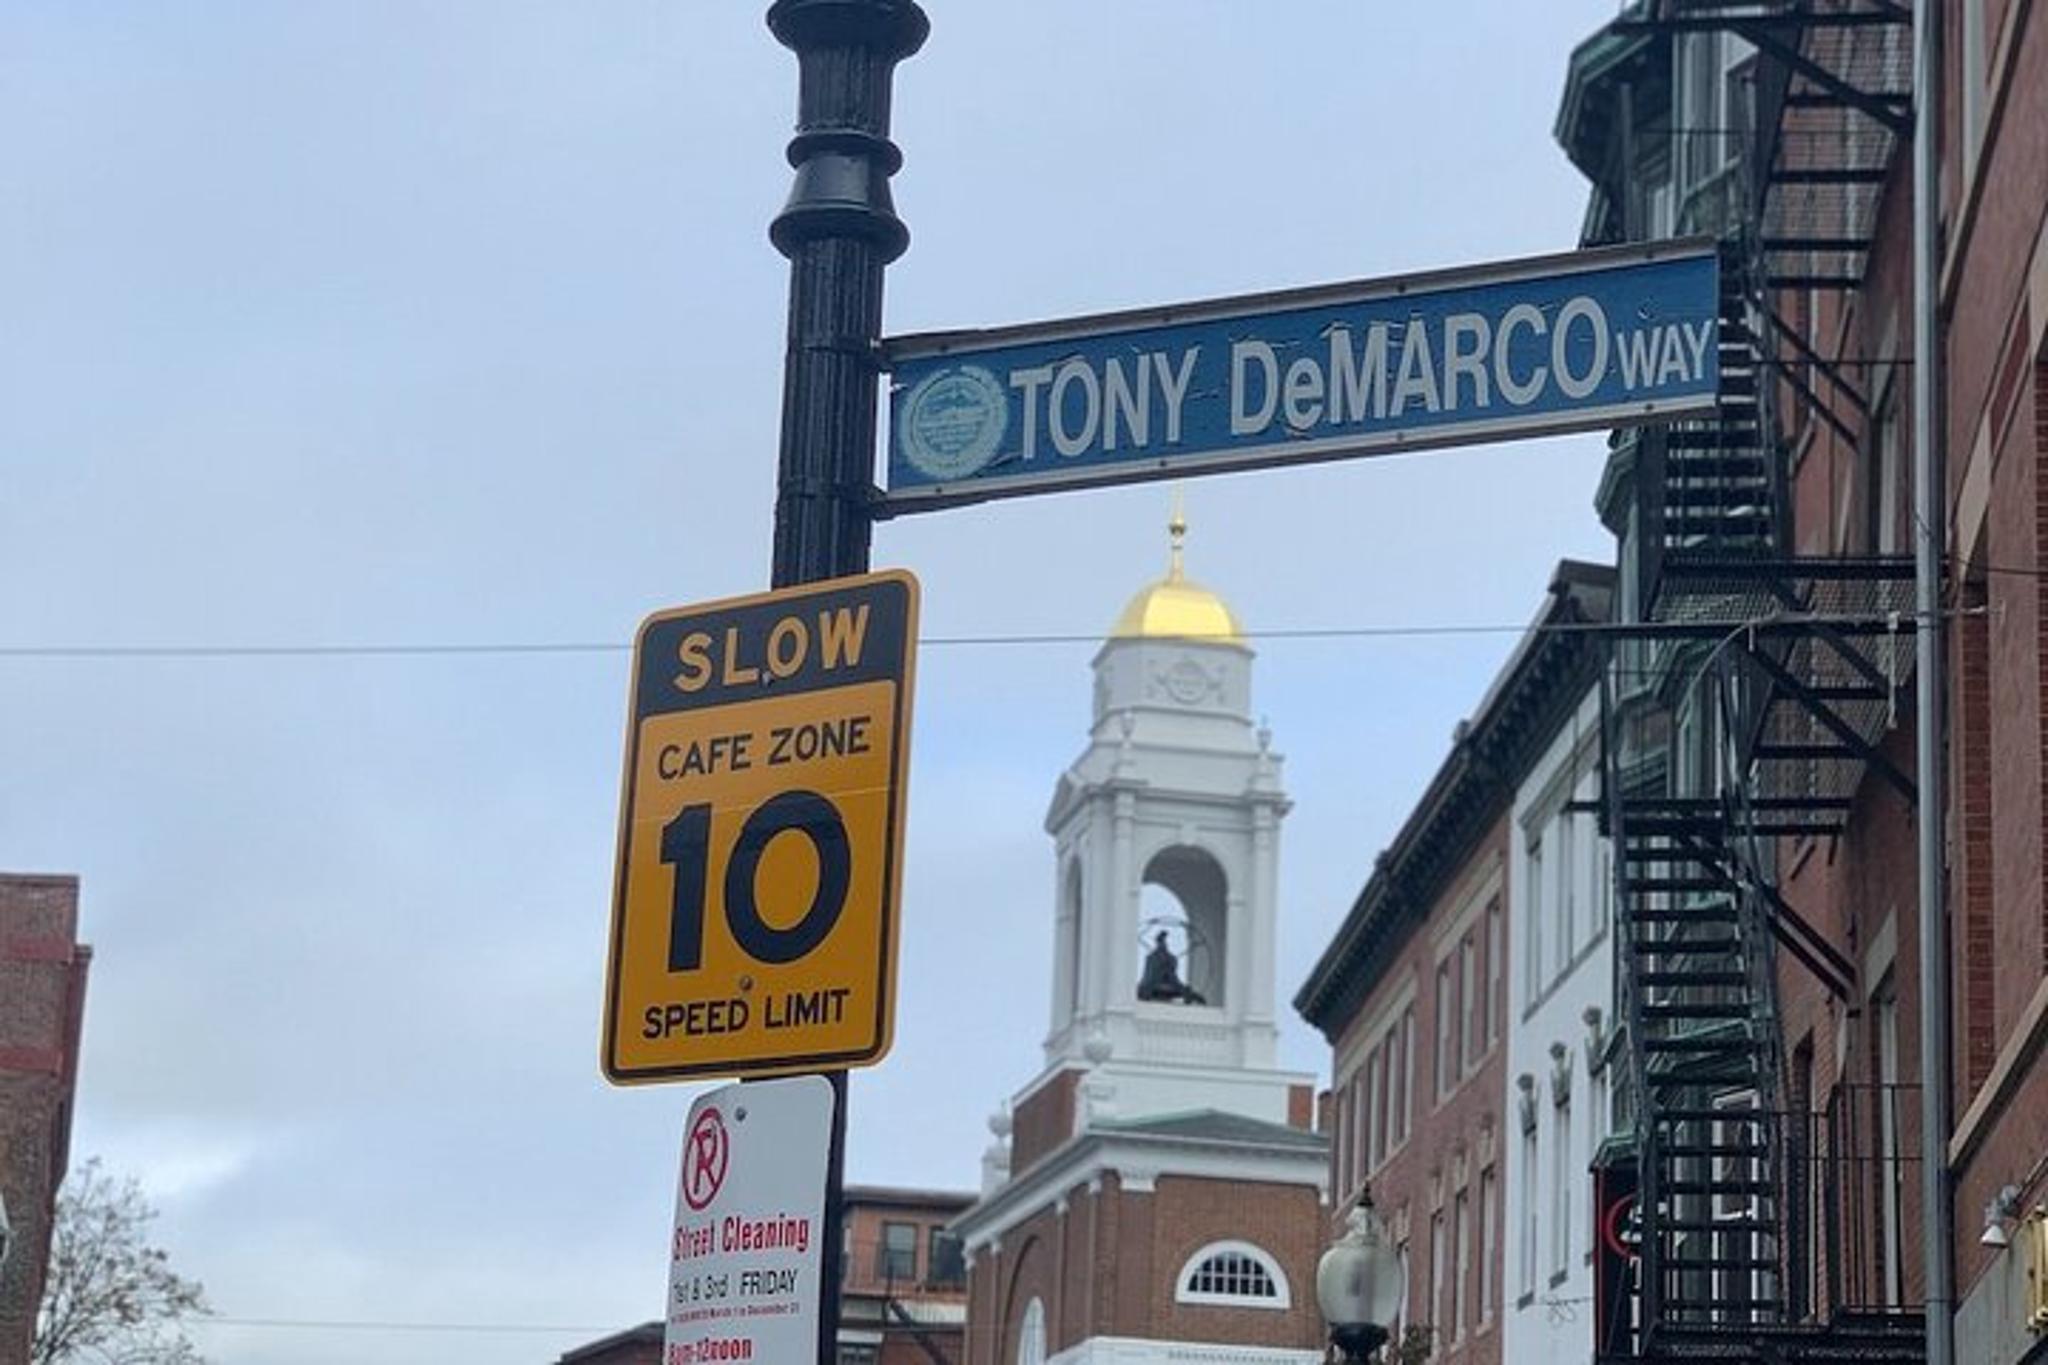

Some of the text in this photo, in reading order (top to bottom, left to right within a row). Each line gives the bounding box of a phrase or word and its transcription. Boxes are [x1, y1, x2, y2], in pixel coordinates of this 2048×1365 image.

[1009, 343, 1201, 460] TONY
[1230, 296, 1609, 437] DeMARCO
[1616, 318, 1715, 391] WAY
[674, 604, 870, 693] SLOW
[658, 716, 872, 781] CAFE ZONE
[659, 789, 852, 974] 10
[642, 989, 851, 1040] SPEED LIMIT
[673, 1213, 809, 1261] Street Cleaning
[704, 1273, 729, 1300] 3rd
[739, 1269, 798, 1296] FRIDAY
